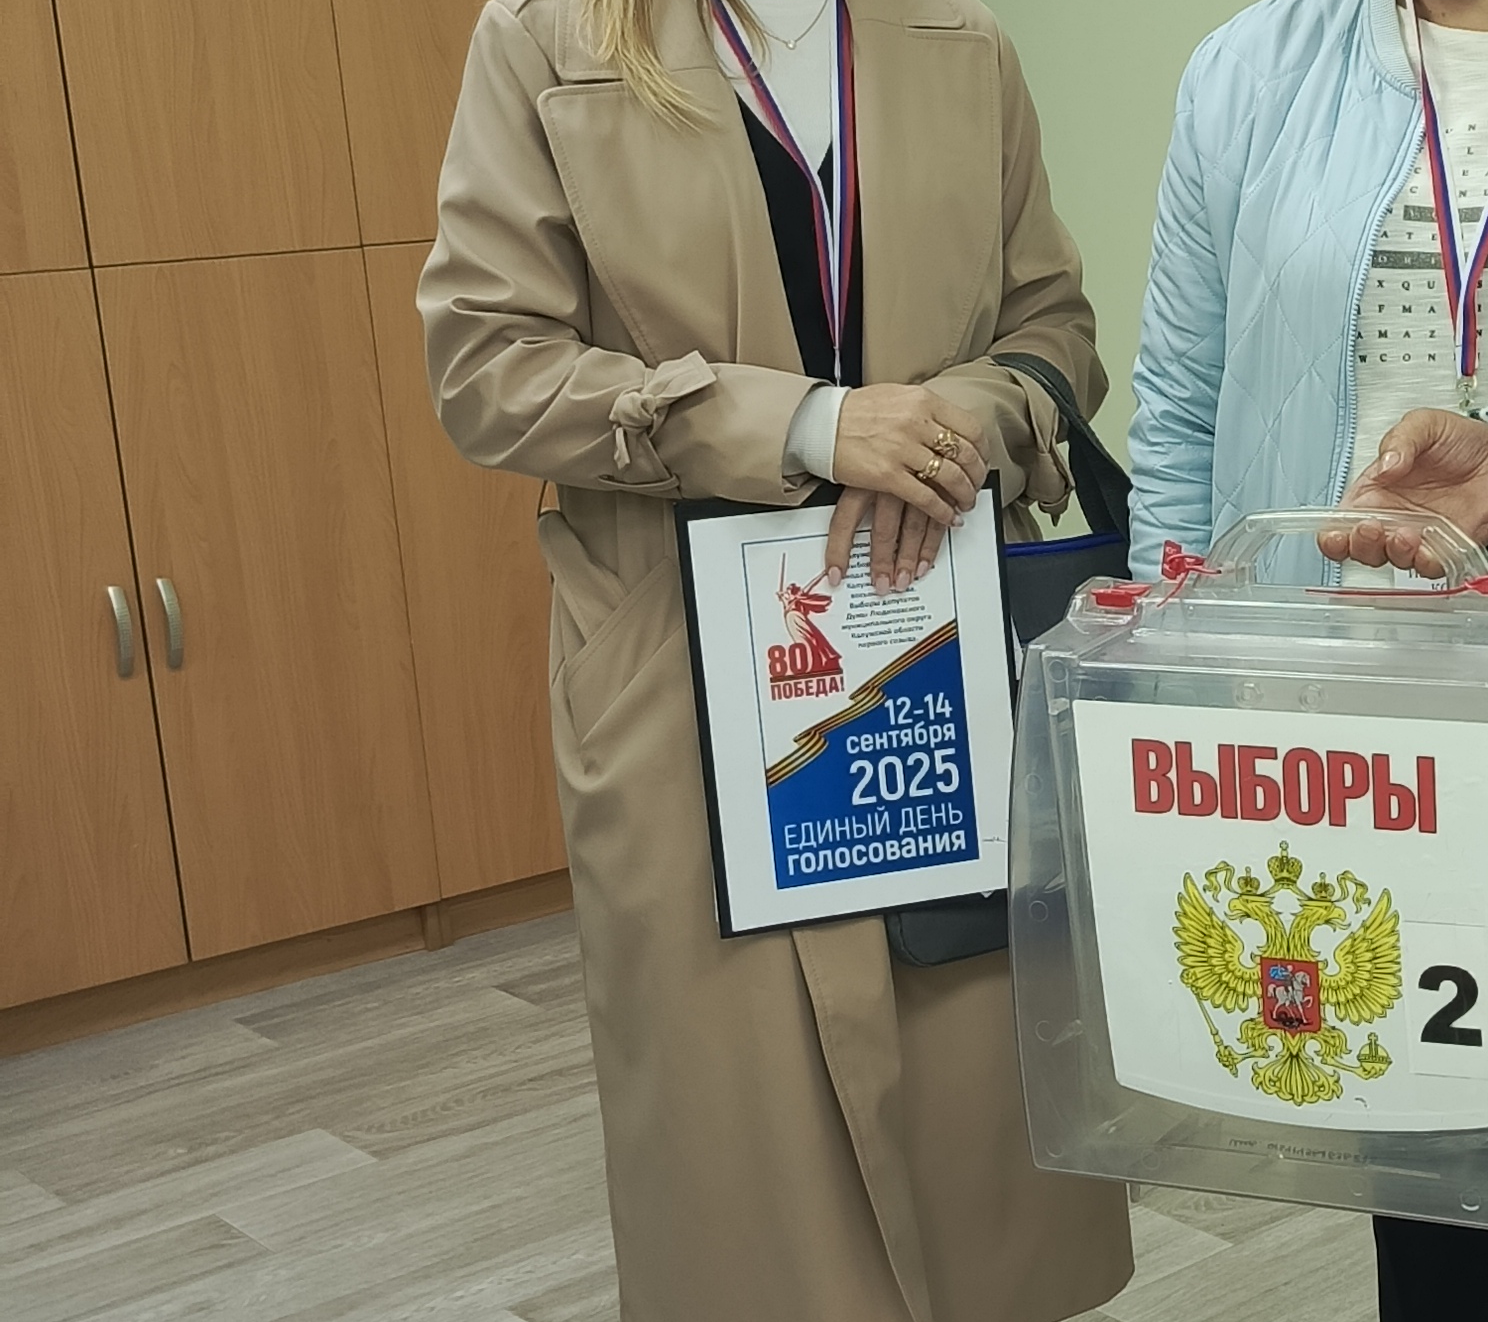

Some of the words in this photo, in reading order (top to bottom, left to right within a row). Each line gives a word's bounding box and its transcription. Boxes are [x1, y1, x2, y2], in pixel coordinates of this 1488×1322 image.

[768, 643, 808, 676] 80
[771, 677, 845, 700] ПОБЕДА!
[885, 693, 952, 725] 12-14
[846, 722, 956, 754] сентября
[850, 748, 959, 806] 2025
[1131, 739, 1438, 834] ВЫБОРЫ
[784, 807, 890, 850] ЕДИНЫЙ
[899, 802, 963, 834] ДЕНЬ
[788, 830, 965, 875] голосования
[1417, 964, 1483, 1048] 2
